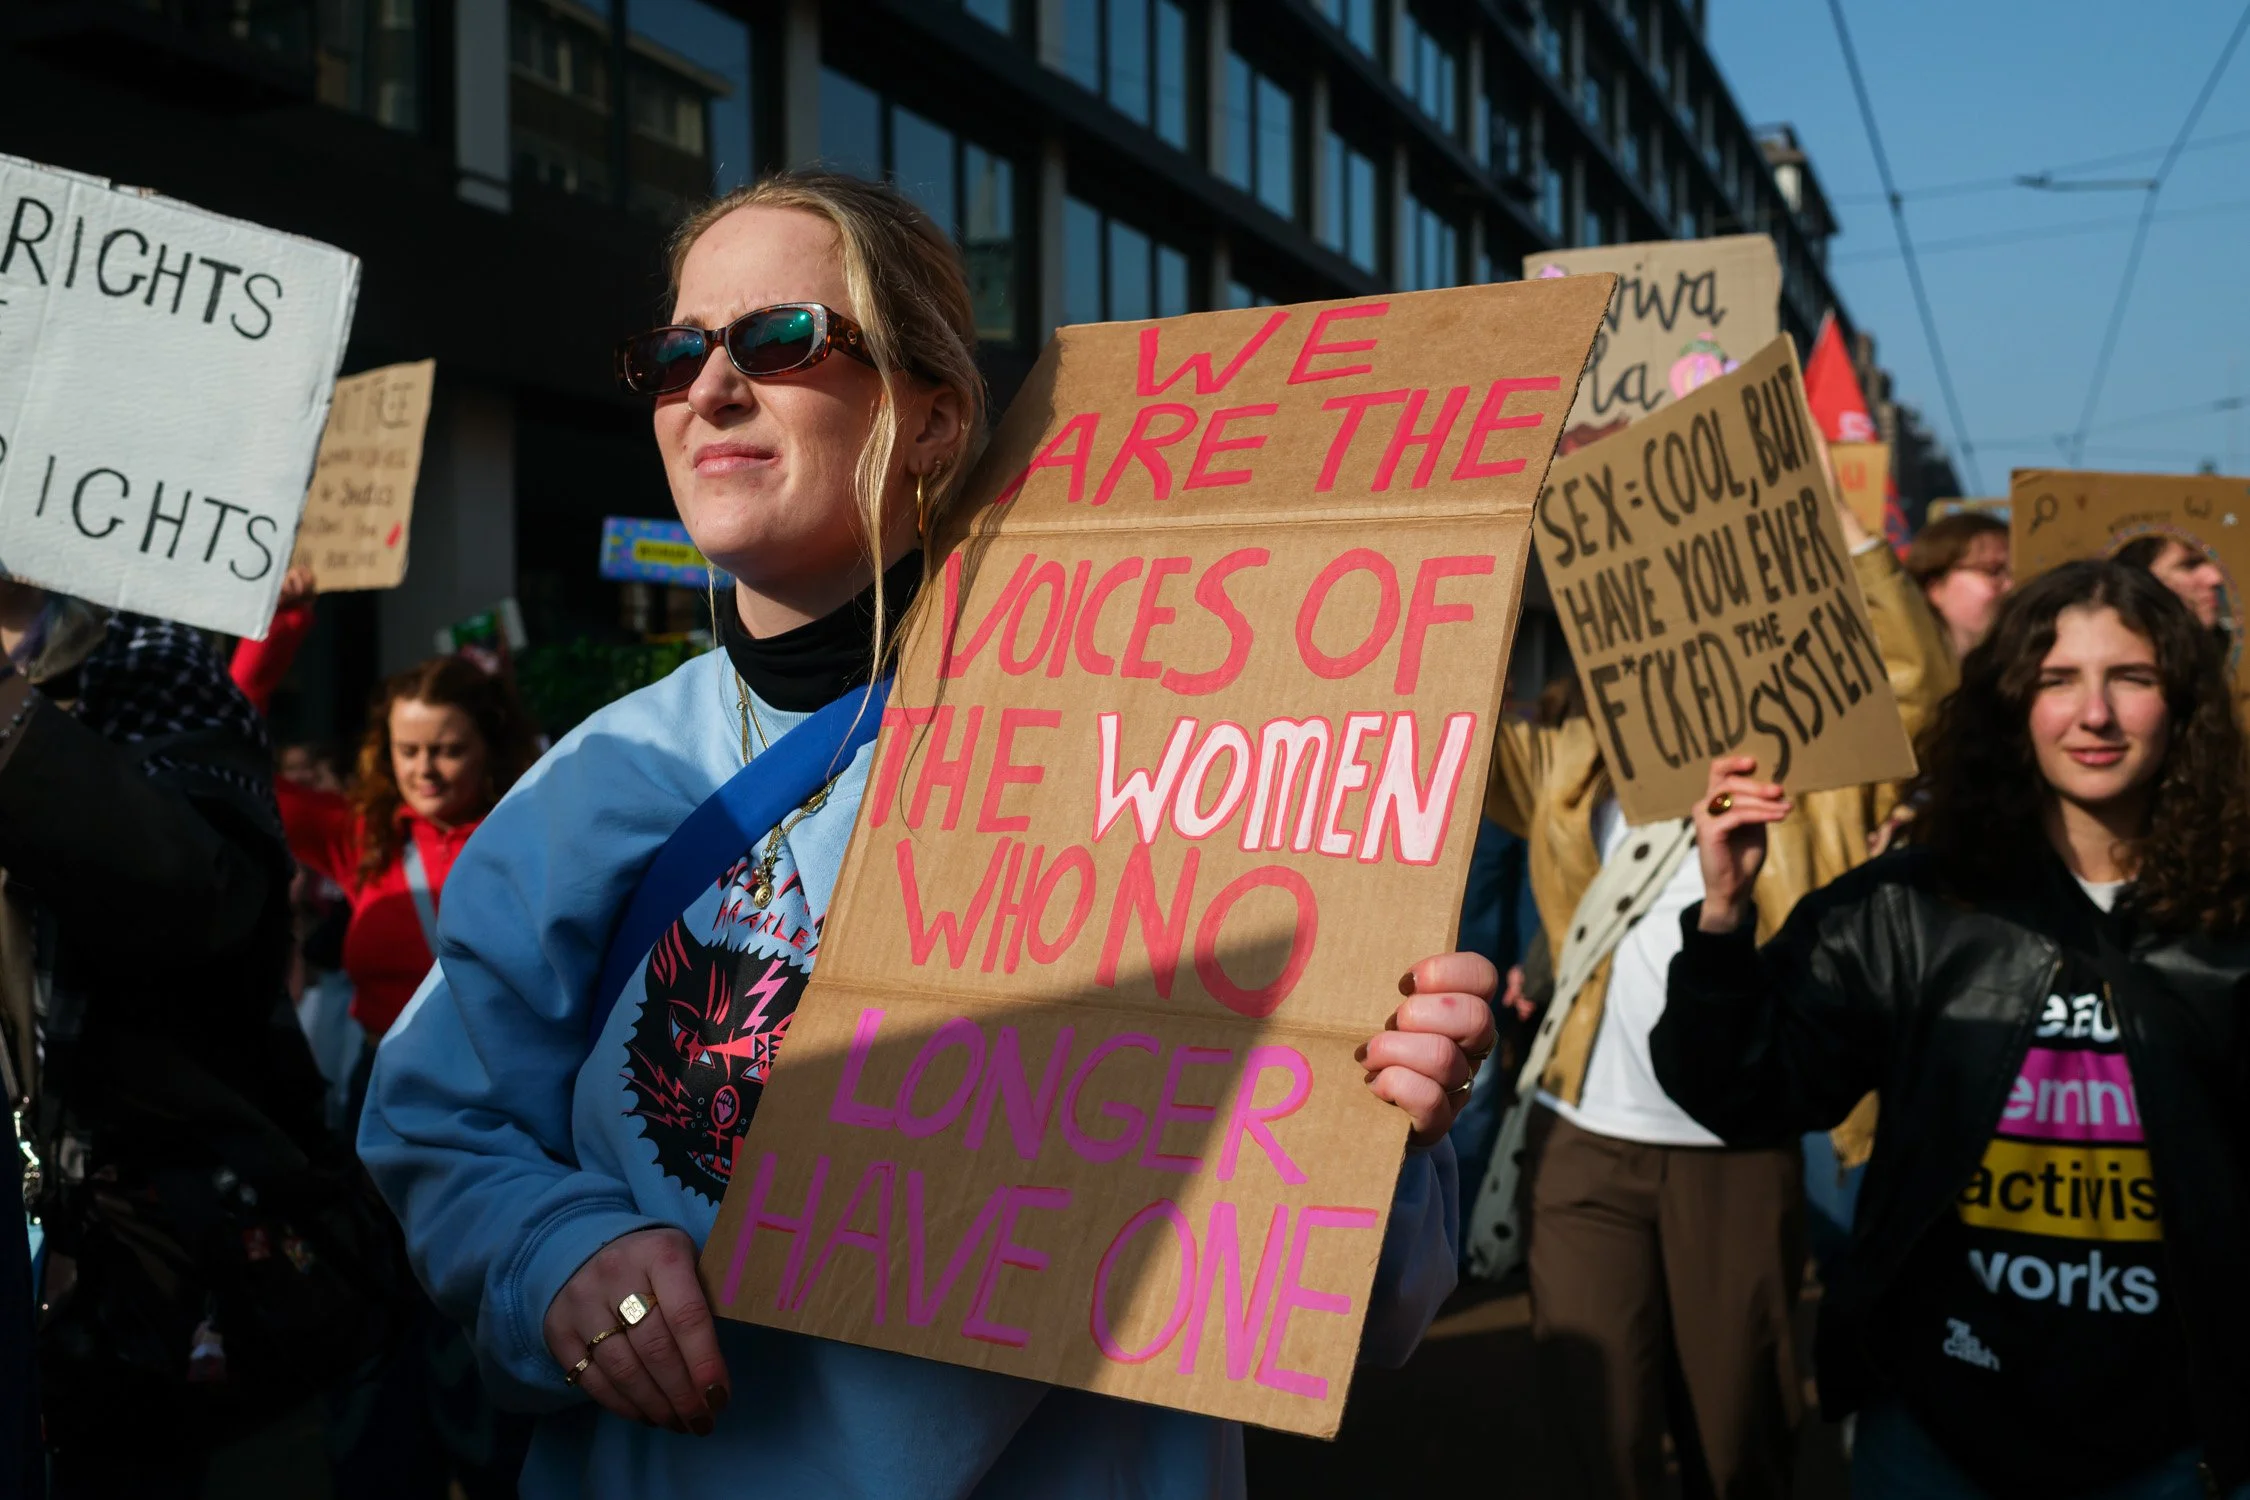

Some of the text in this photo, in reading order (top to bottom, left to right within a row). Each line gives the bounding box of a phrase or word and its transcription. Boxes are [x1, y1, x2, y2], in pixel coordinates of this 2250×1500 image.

[0, 197, 283, 340] RIGHTS
[1136, 301, 1390, 397] WE
[995, 376, 1561, 506] ARE THE
[1740, 364, 1810, 488] BUT
[0, 434, 278, 582] IGHTS
[1564, 486, 1846, 656] HAVE YOU EVER
[936, 547, 1496, 697] VOICES OF
[1733, 612, 1786, 657] THE
[1750, 586, 1889, 785] SYSTEM
[868, 704, 1478, 866] THE WOMEN
[896, 838, 1097, 974] WHO
[1095, 841, 1319, 1018] NO
[828, 1007, 1314, 1186] LONGER
[719, 1151, 1379, 1400] HAVE ONE
